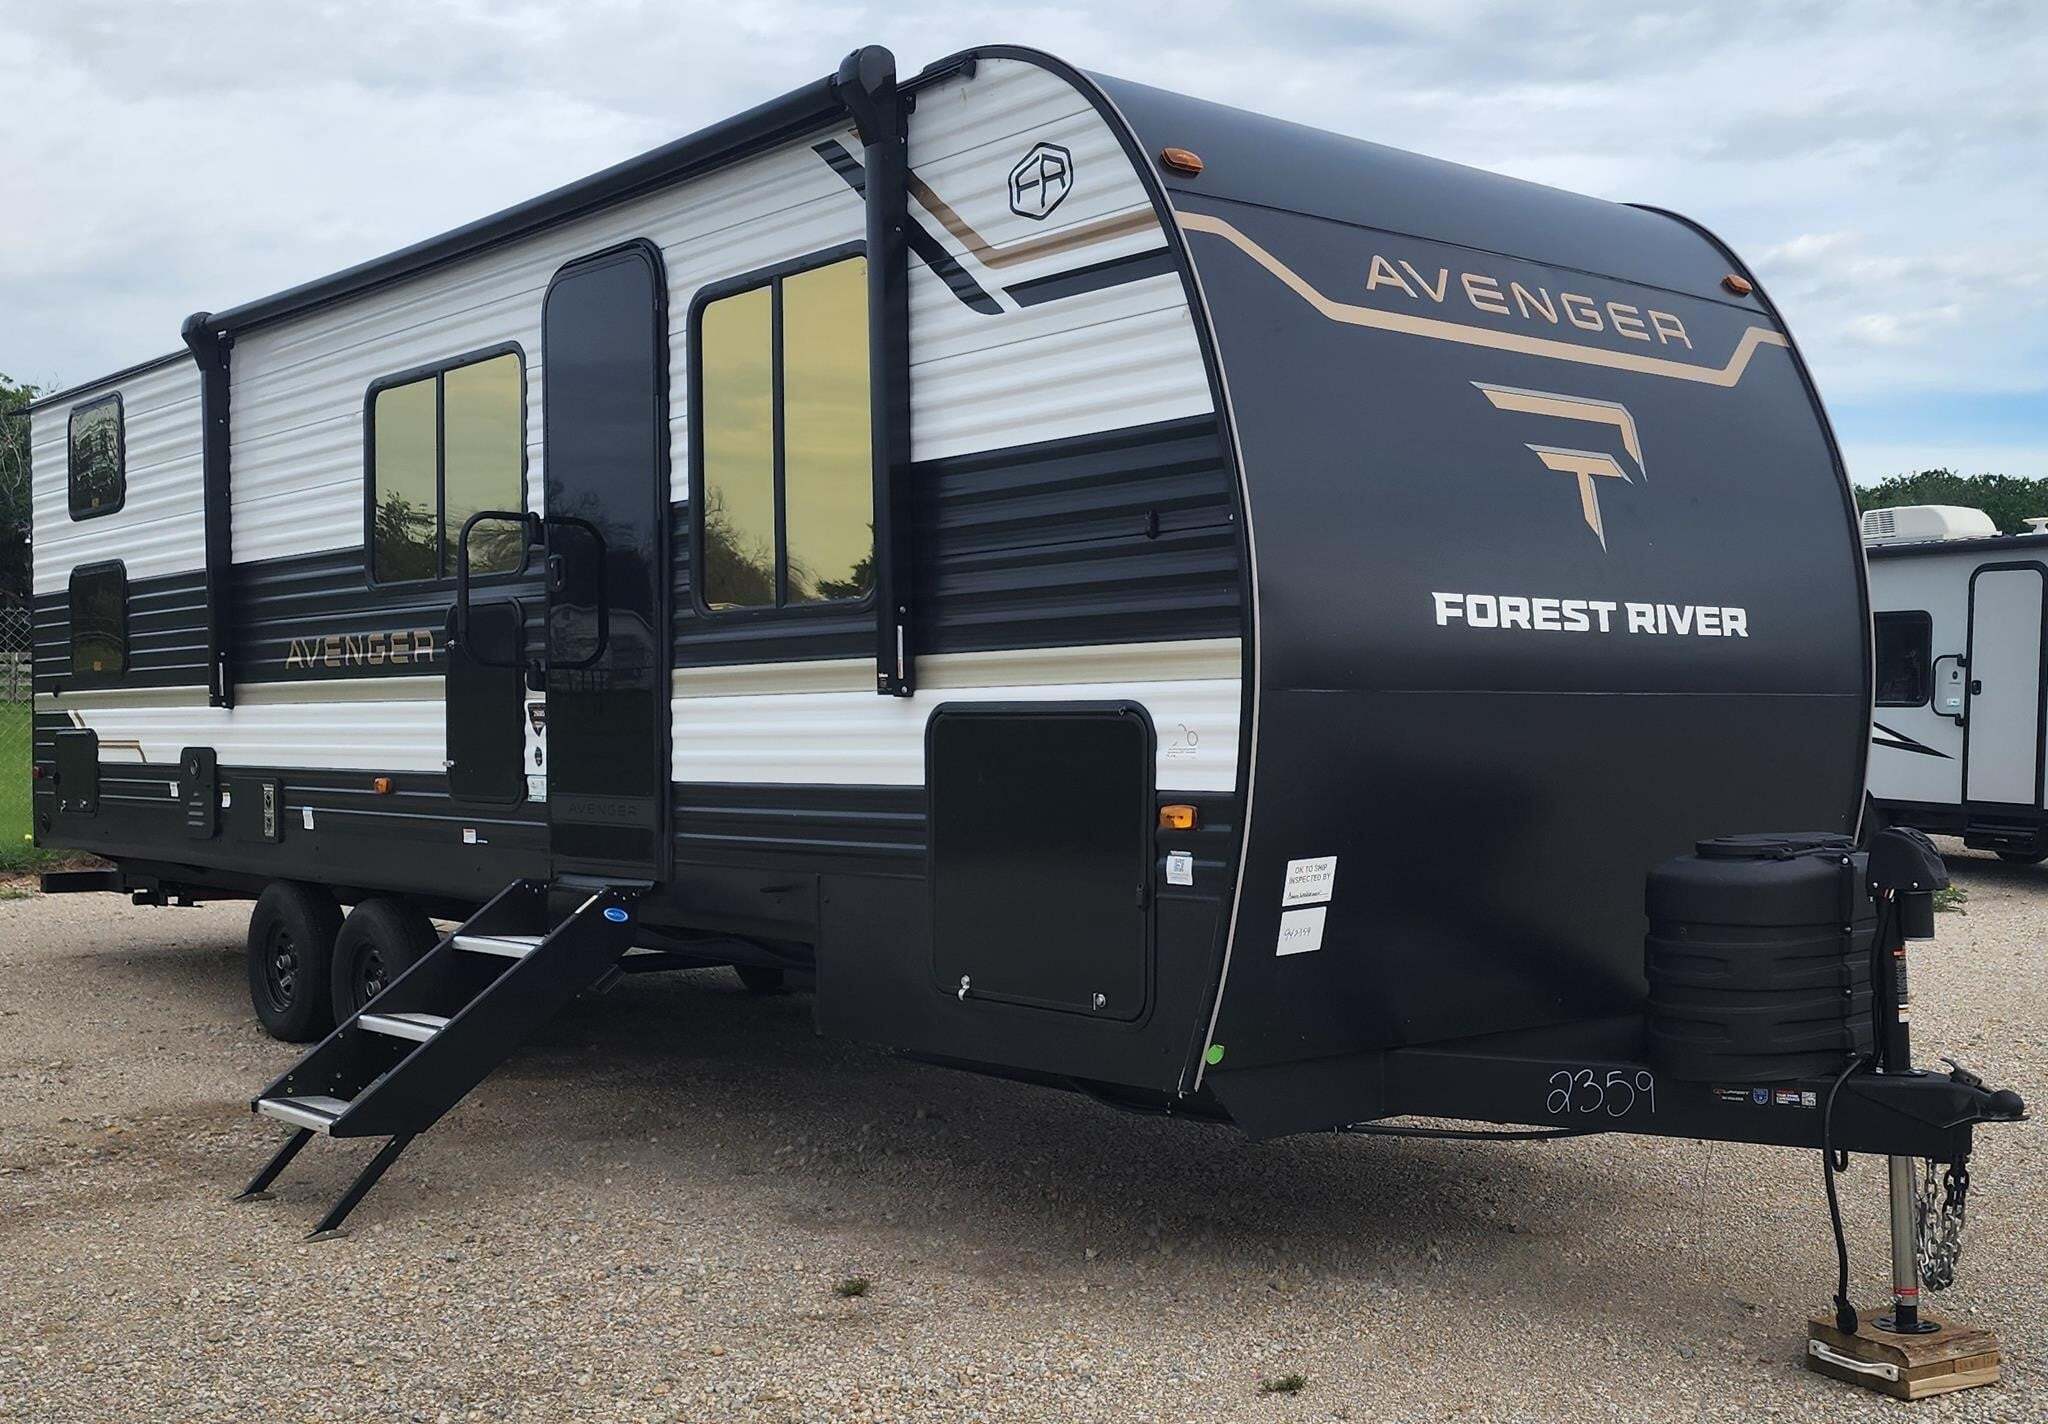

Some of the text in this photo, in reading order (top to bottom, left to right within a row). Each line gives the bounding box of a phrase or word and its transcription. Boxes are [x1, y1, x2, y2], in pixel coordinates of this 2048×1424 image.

[1366, 254, 1694, 350] AVENGER
[1431, 592, 1749, 637] FOREST RIVER
[284, 630, 435, 670] AVENGER
[567, 801, 639, 817] AVENGER
[1288, 873, 1331, 885] INSPECTED BY
[1305, 865, 1313, 873] TO
[1547, 1069, 1655, 1117] 2359
